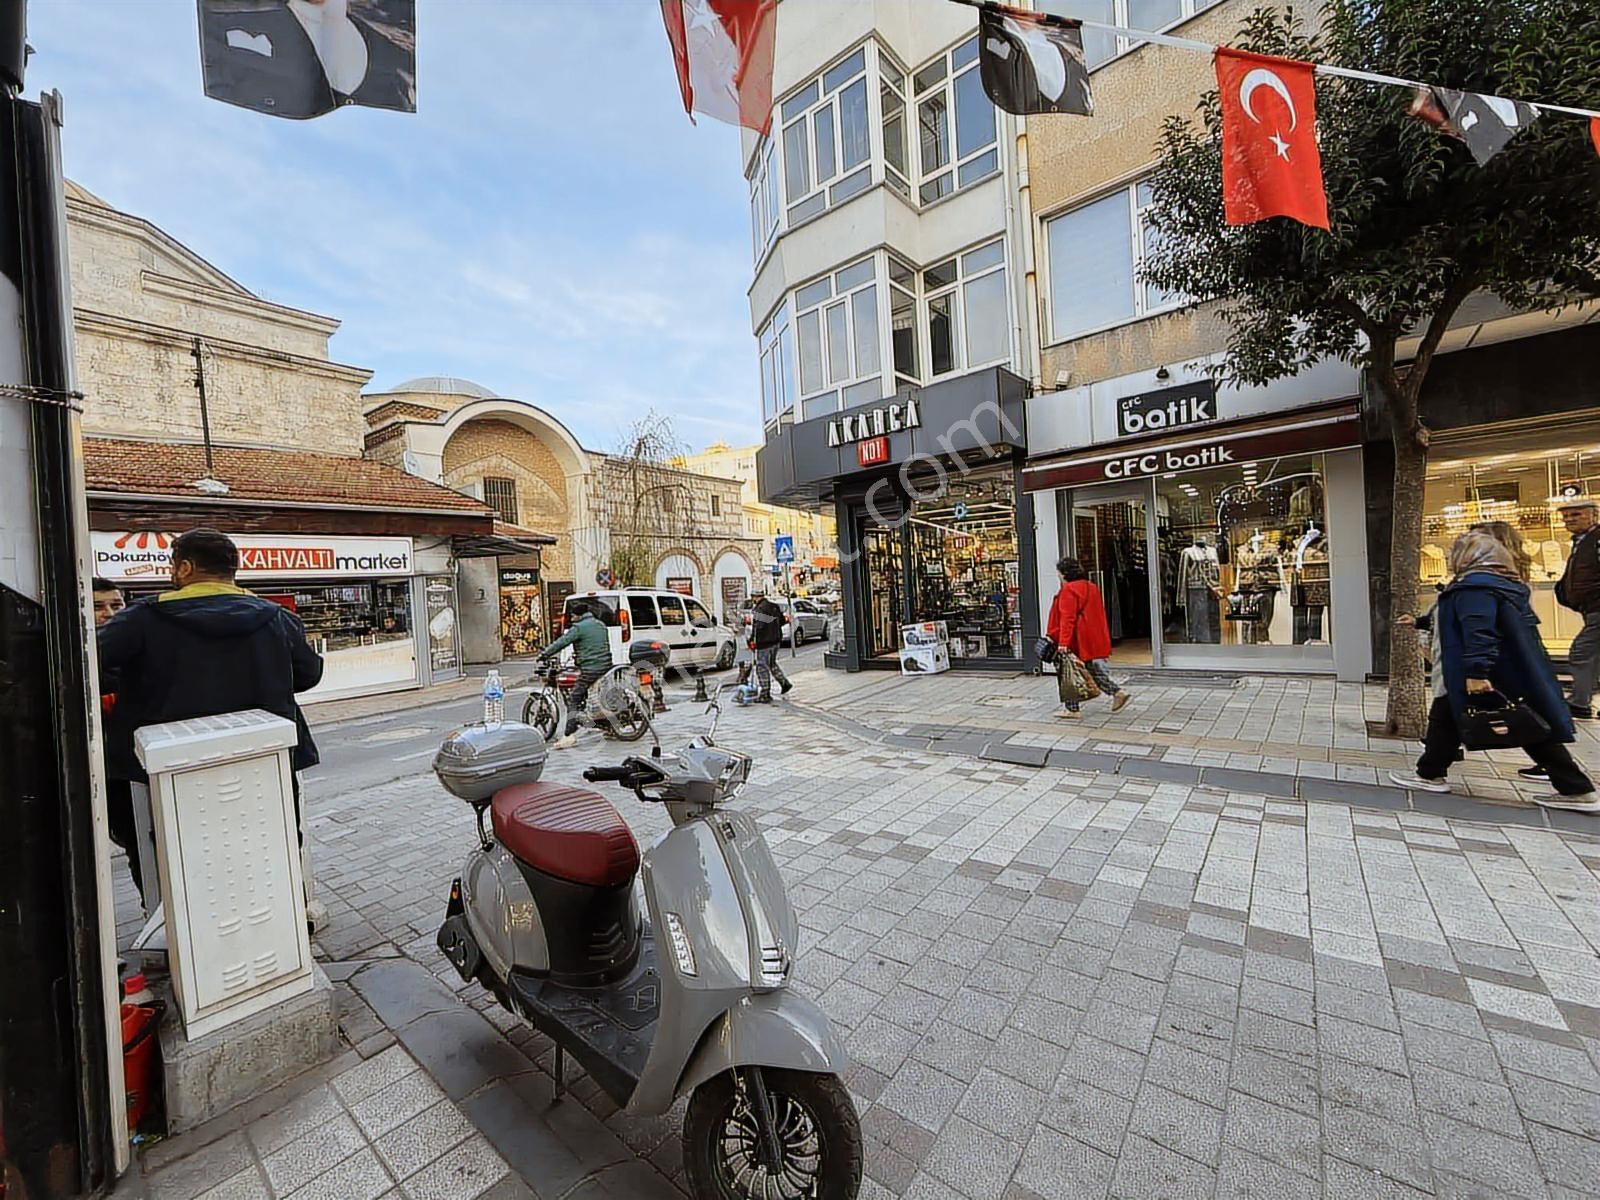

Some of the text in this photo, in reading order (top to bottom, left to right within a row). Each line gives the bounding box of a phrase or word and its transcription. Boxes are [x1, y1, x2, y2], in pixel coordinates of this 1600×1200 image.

[1123, 397, 1210, 433] batik
[1103, 446, 1235, 479] CFC batik
[239, 549, 408, 570] KAHVALTI market
